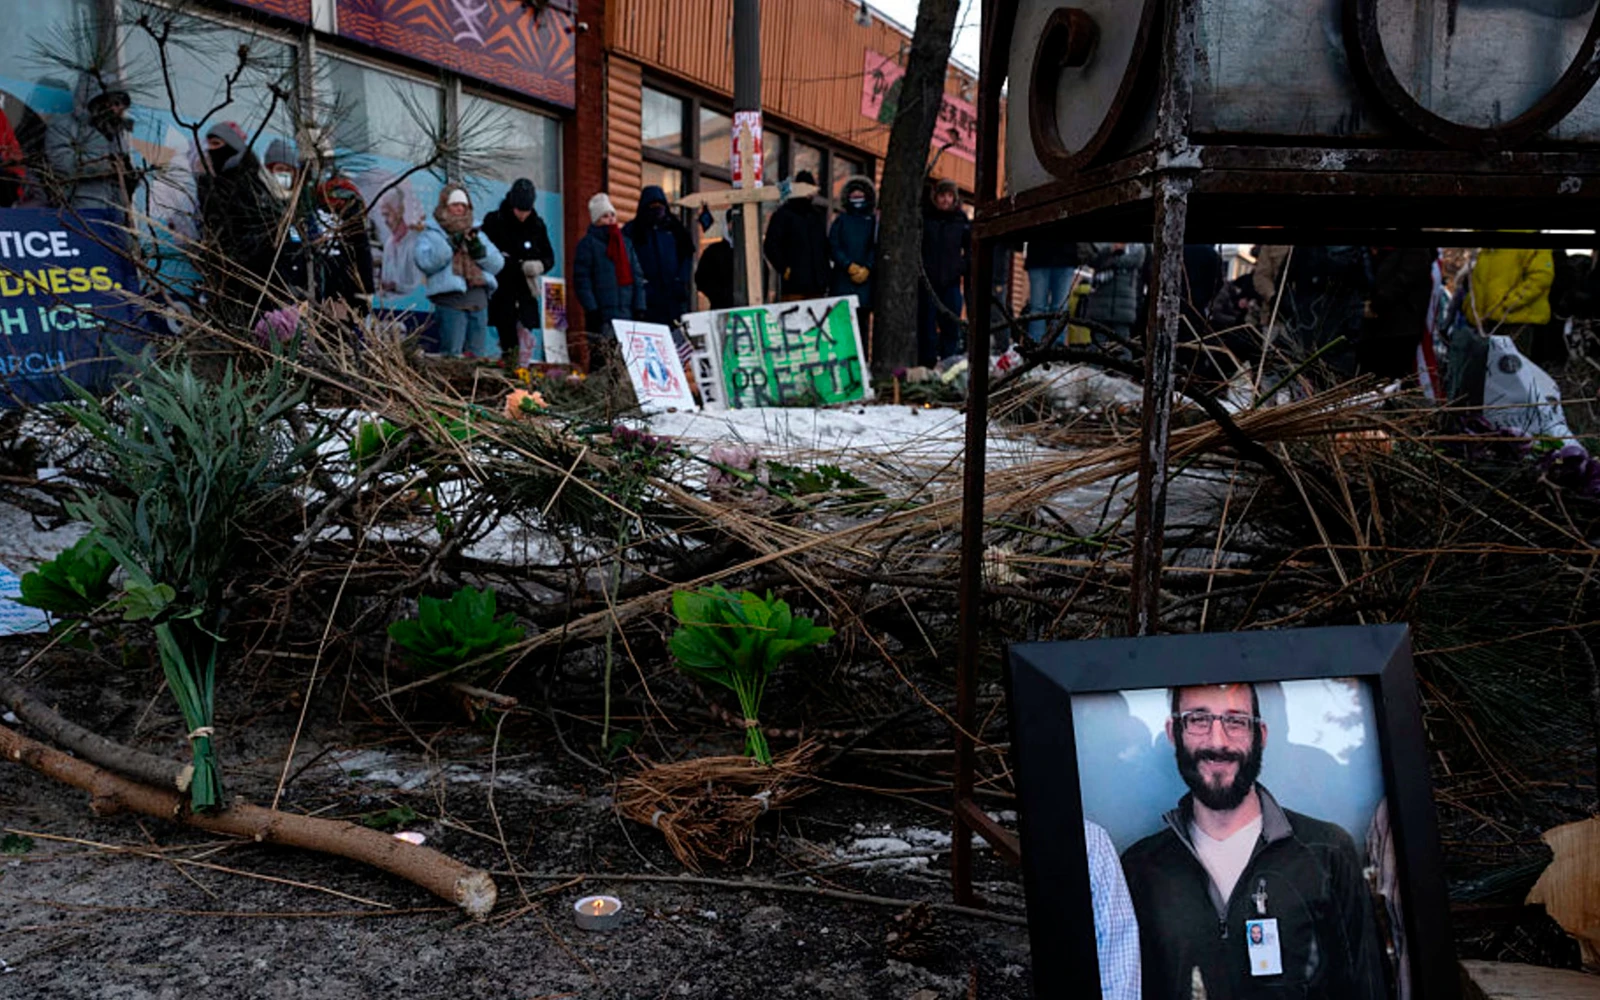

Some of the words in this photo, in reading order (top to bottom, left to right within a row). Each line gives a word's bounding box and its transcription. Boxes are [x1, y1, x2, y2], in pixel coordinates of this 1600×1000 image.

[0, 231, 80, 258] TICE.
[0, 266, 122, 297] DNESS.
[0, 307, 29, 335] H
[38, 303, 105, 333] ICE.
[732, 304, 837, 355] ALEX
[731, 355, 861, 409] PRETTI
